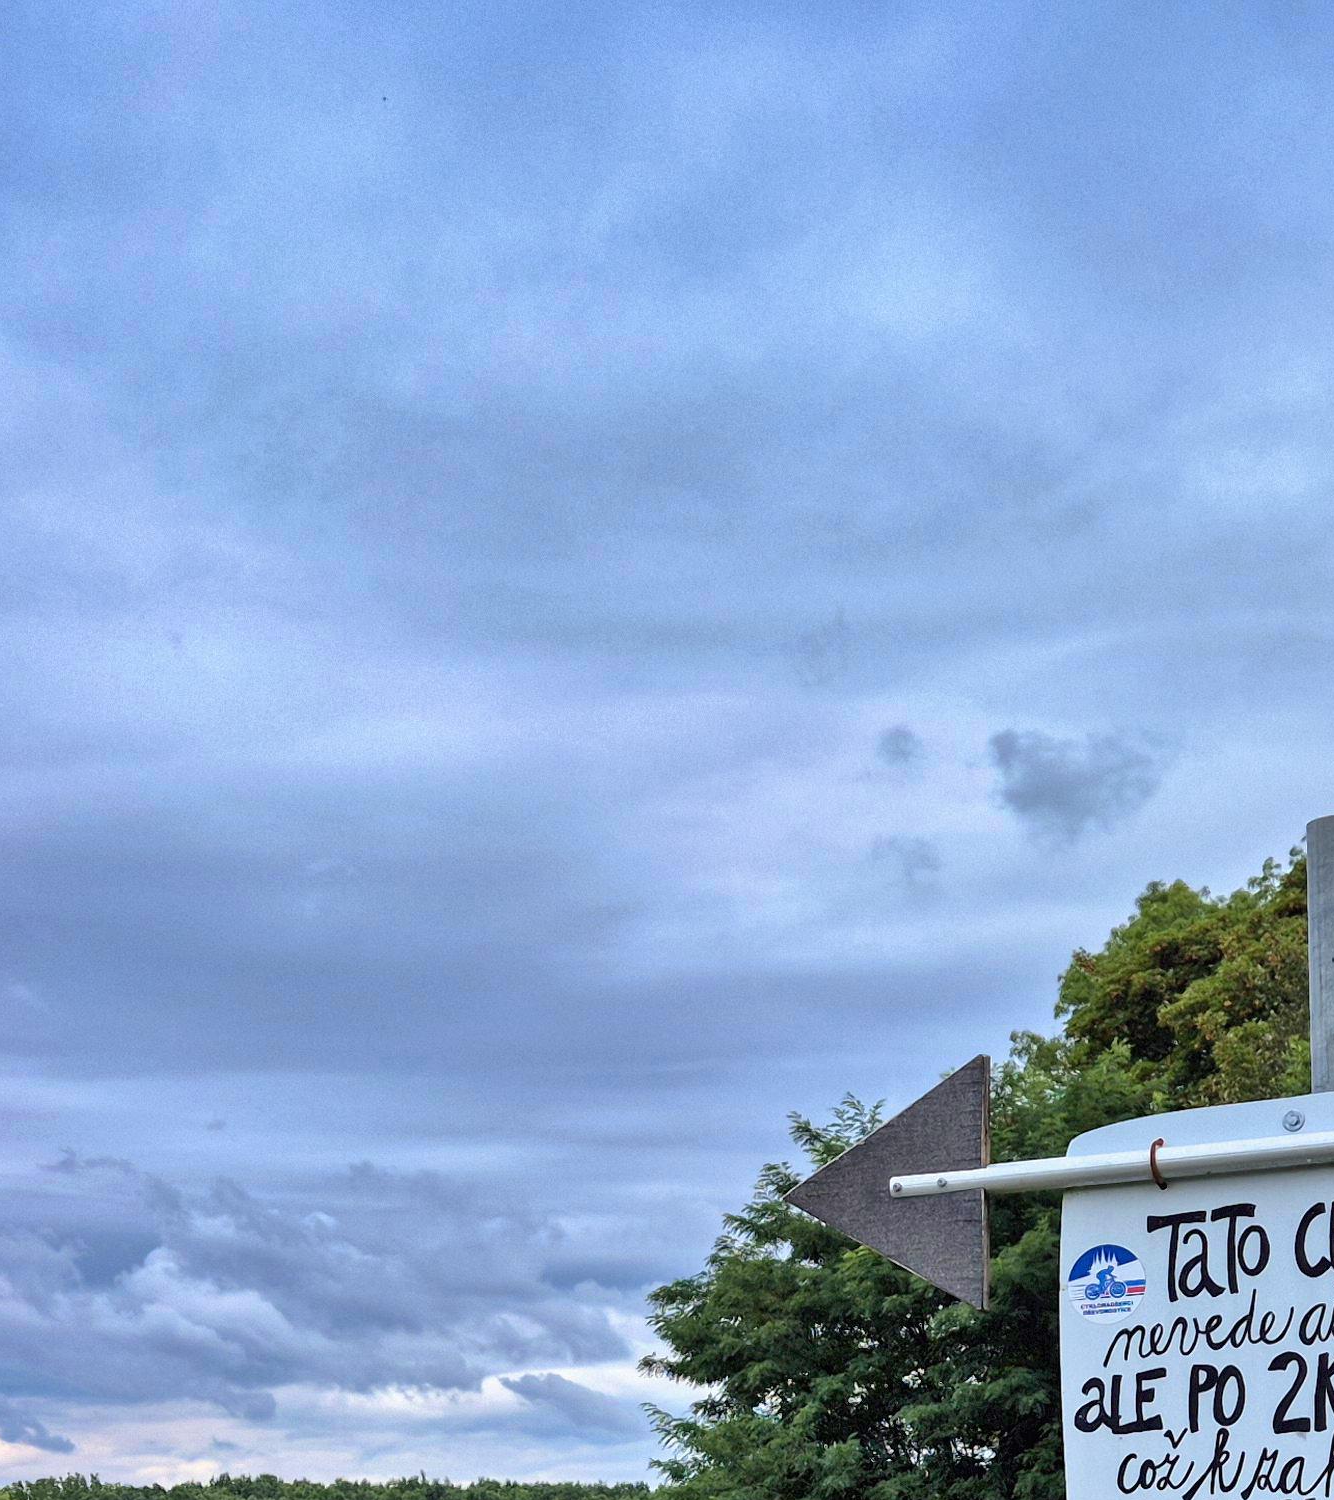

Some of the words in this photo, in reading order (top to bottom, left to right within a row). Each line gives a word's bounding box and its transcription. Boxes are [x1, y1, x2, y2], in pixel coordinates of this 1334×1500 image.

[1103, 1288, 1294, 1368] nevede
[1188, 1364, 1246, 1433] PO
[1117, 1427, 1195, 1494] což
